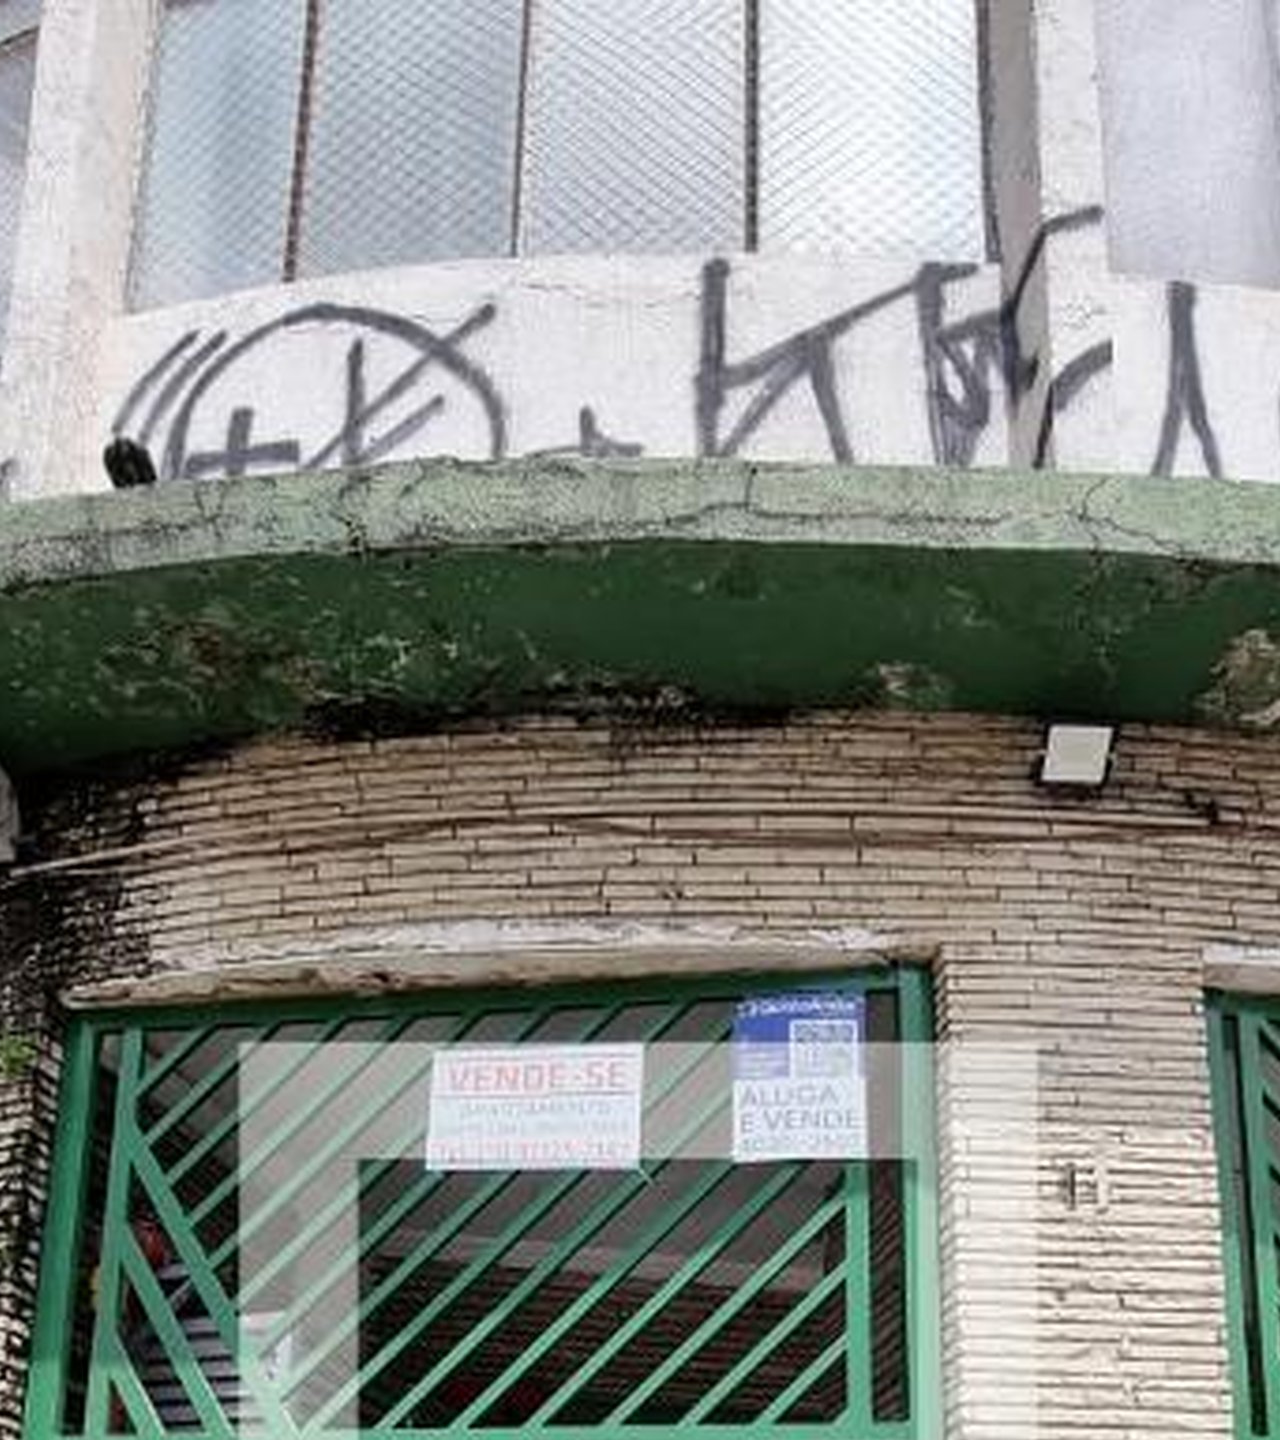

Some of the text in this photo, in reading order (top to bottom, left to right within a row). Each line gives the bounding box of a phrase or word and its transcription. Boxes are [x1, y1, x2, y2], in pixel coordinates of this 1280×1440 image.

[449, 1061, 628, 1092] VENDE-SE
[741, 1085, 840, 1109] ALUGA
[740, 1108, 863, 1134] E VENDE
